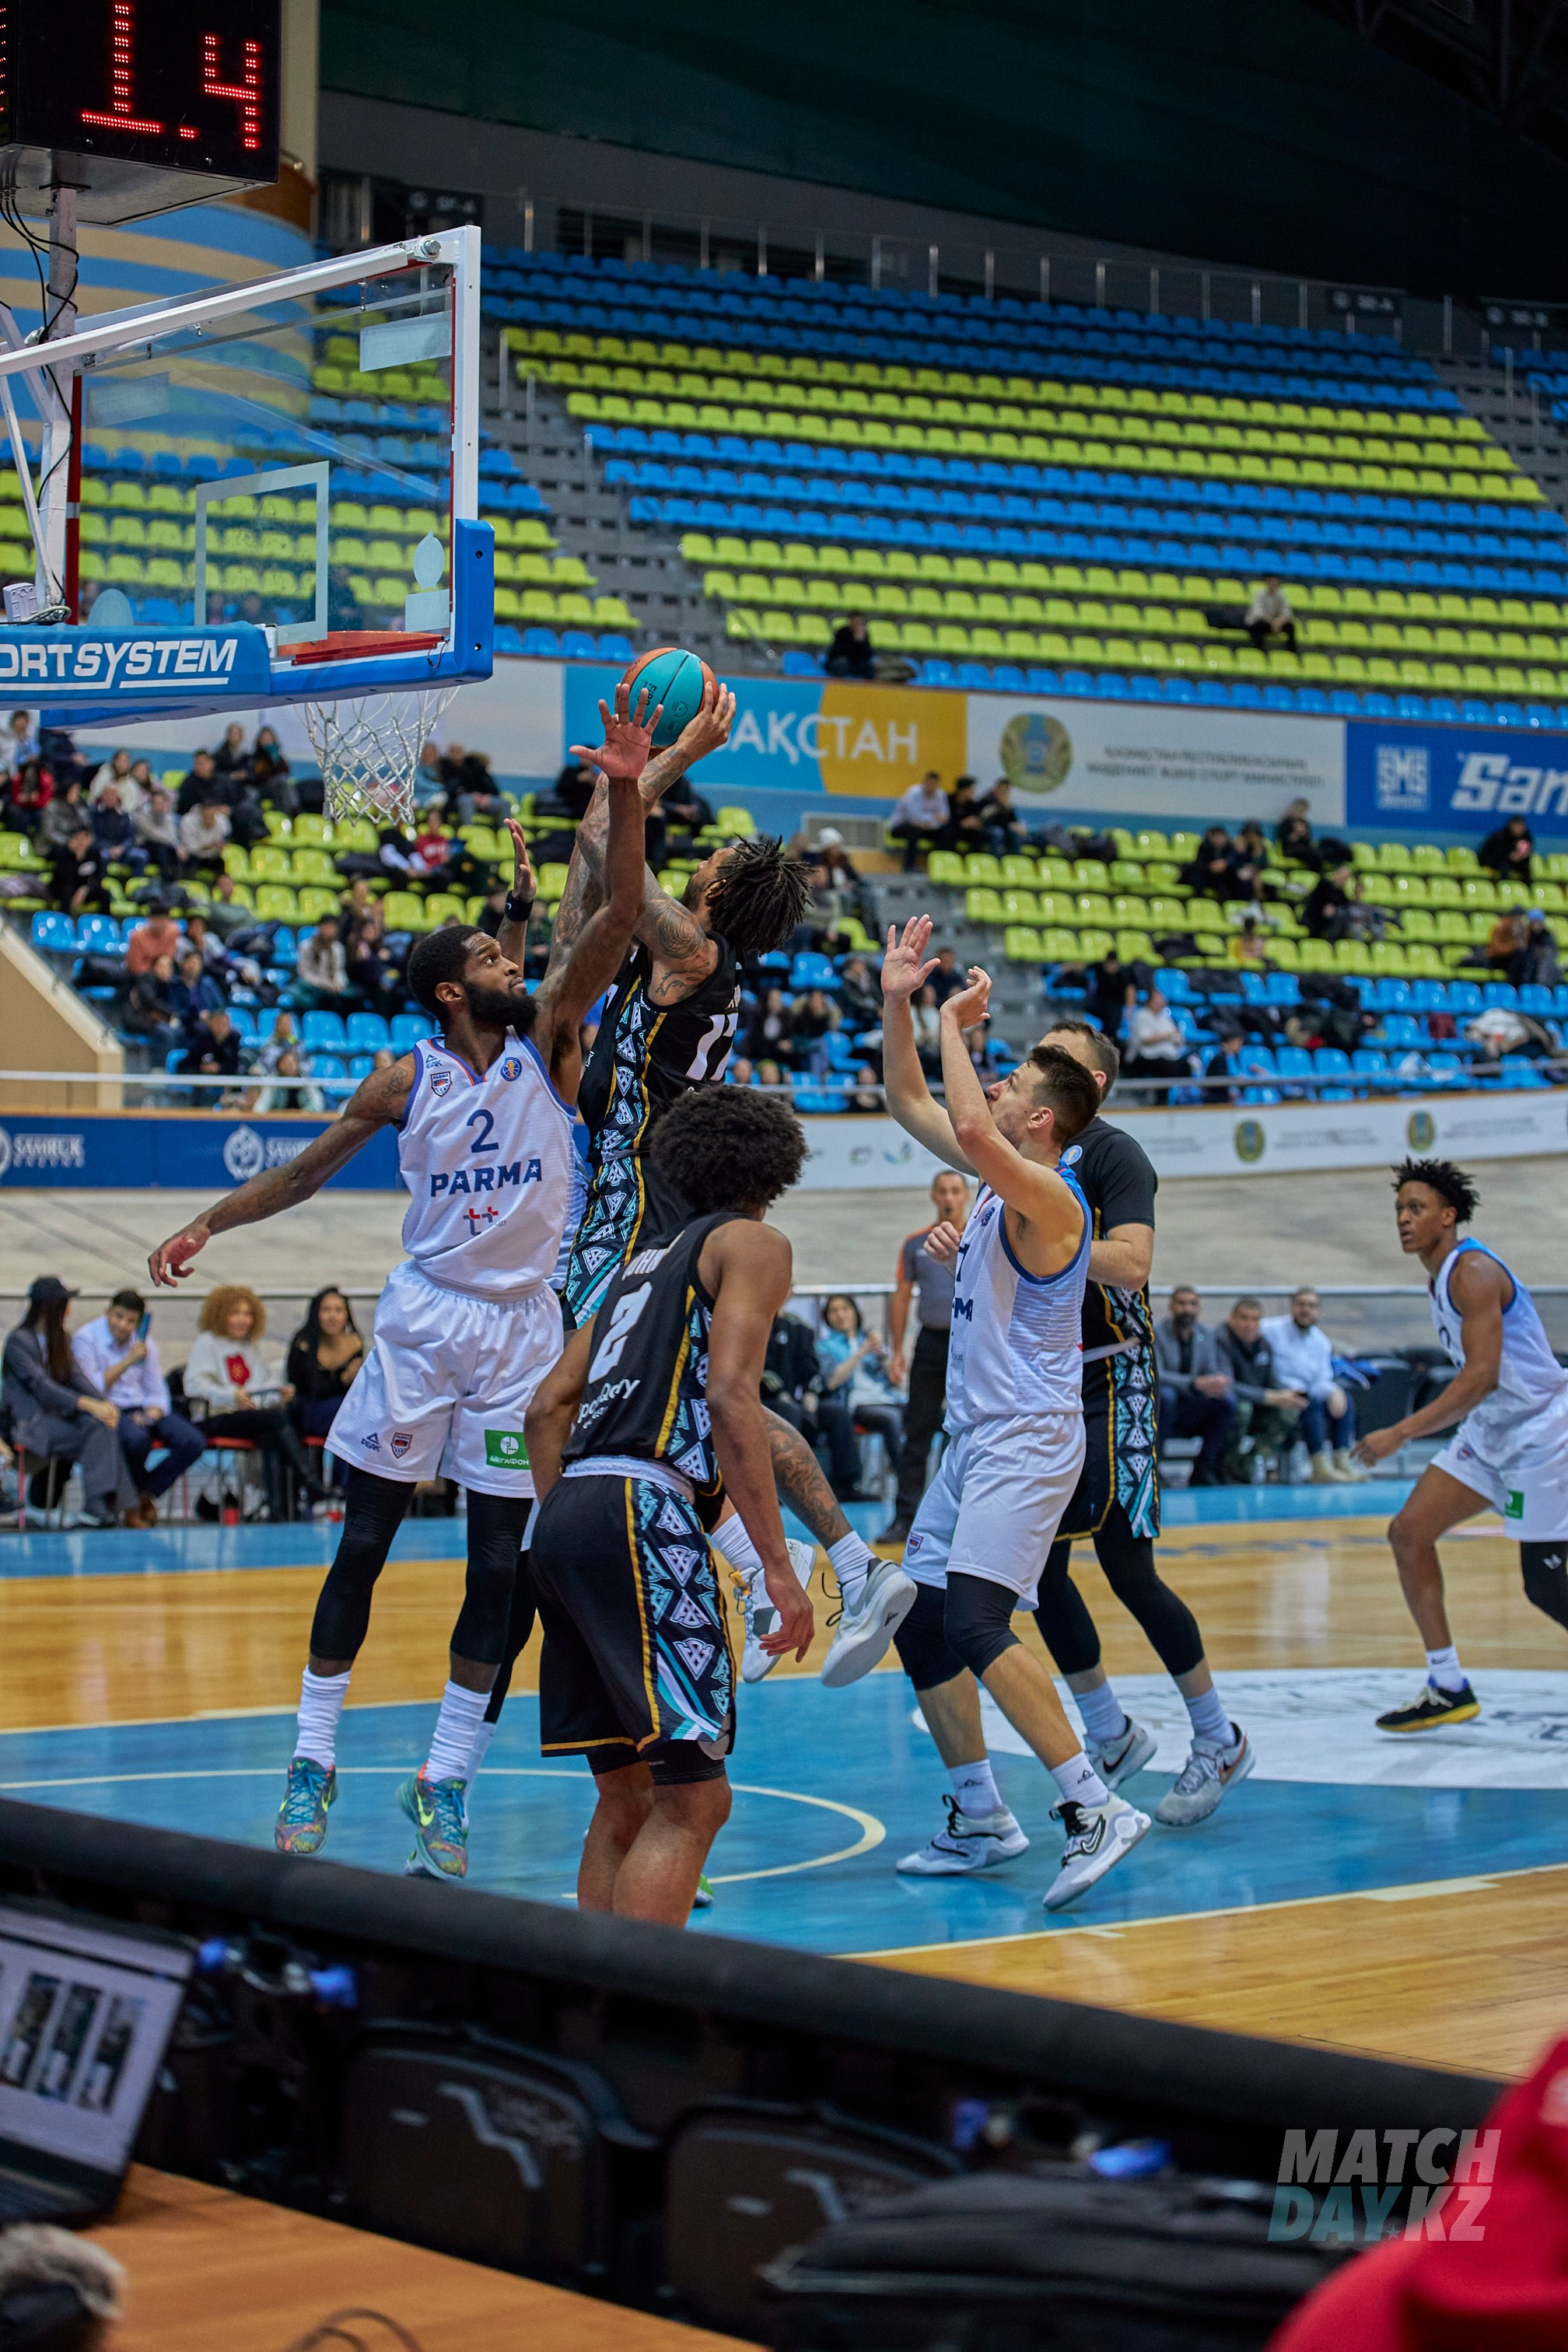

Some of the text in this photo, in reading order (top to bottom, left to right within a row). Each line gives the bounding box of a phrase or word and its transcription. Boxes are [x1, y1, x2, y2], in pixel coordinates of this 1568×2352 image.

[714, 709, 919, 766] АҚСТАН
[467, 1109, 499, 1153] 2
[430, 1158, 543, 1198] PARMA
[588, 1281, 653, 1384] 2
